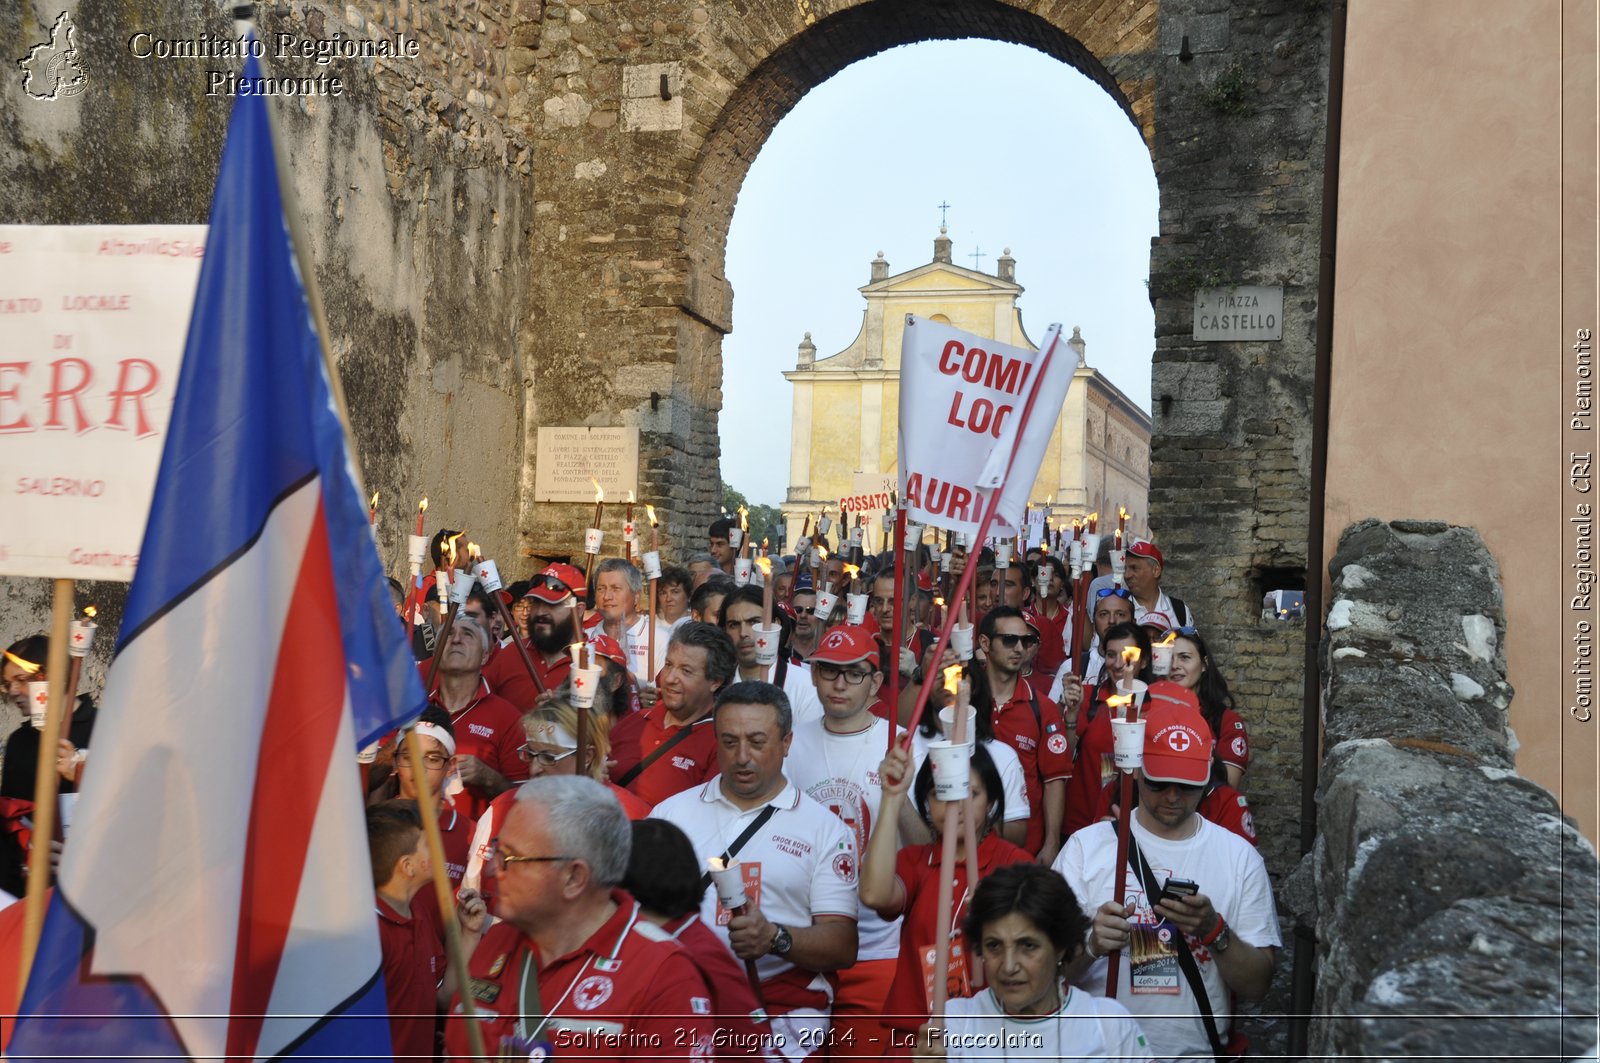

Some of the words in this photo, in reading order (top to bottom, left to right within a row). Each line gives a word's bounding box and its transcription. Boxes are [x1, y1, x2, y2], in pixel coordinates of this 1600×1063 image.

[62, 295, 131, 311] LOCALE
[1218, 295, 1259, 308] PIAZZA
[1200, 314, 1276, 330] CASTELLO
[15, 477, 106, 497] SALERNO
[840, 492, 890, 513] COSSATO
[772, 835, 792, 846] CROCE
[776, 844, 802, 858] ITALIANA
[1156, 957, 1176, 968] 2014
